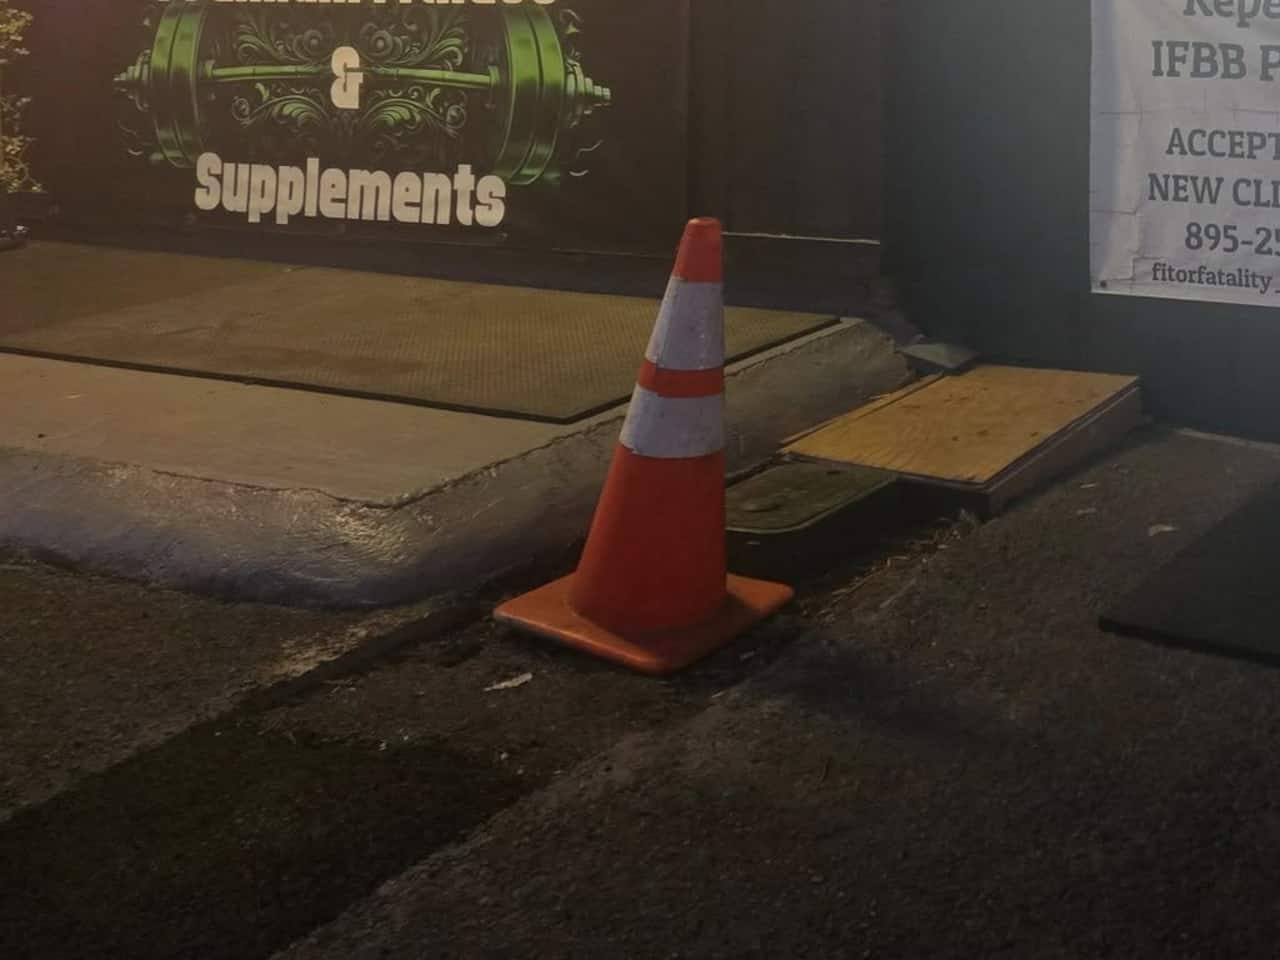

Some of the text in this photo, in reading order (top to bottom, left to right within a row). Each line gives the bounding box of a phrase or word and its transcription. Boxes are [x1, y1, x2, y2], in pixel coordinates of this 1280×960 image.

[330, 46, 363, 109] &
[1151, 41, 1248, 80] IFBB
[194, 152, 507, 227] Supplements
[1147, 173, 1225, 204] NEW
